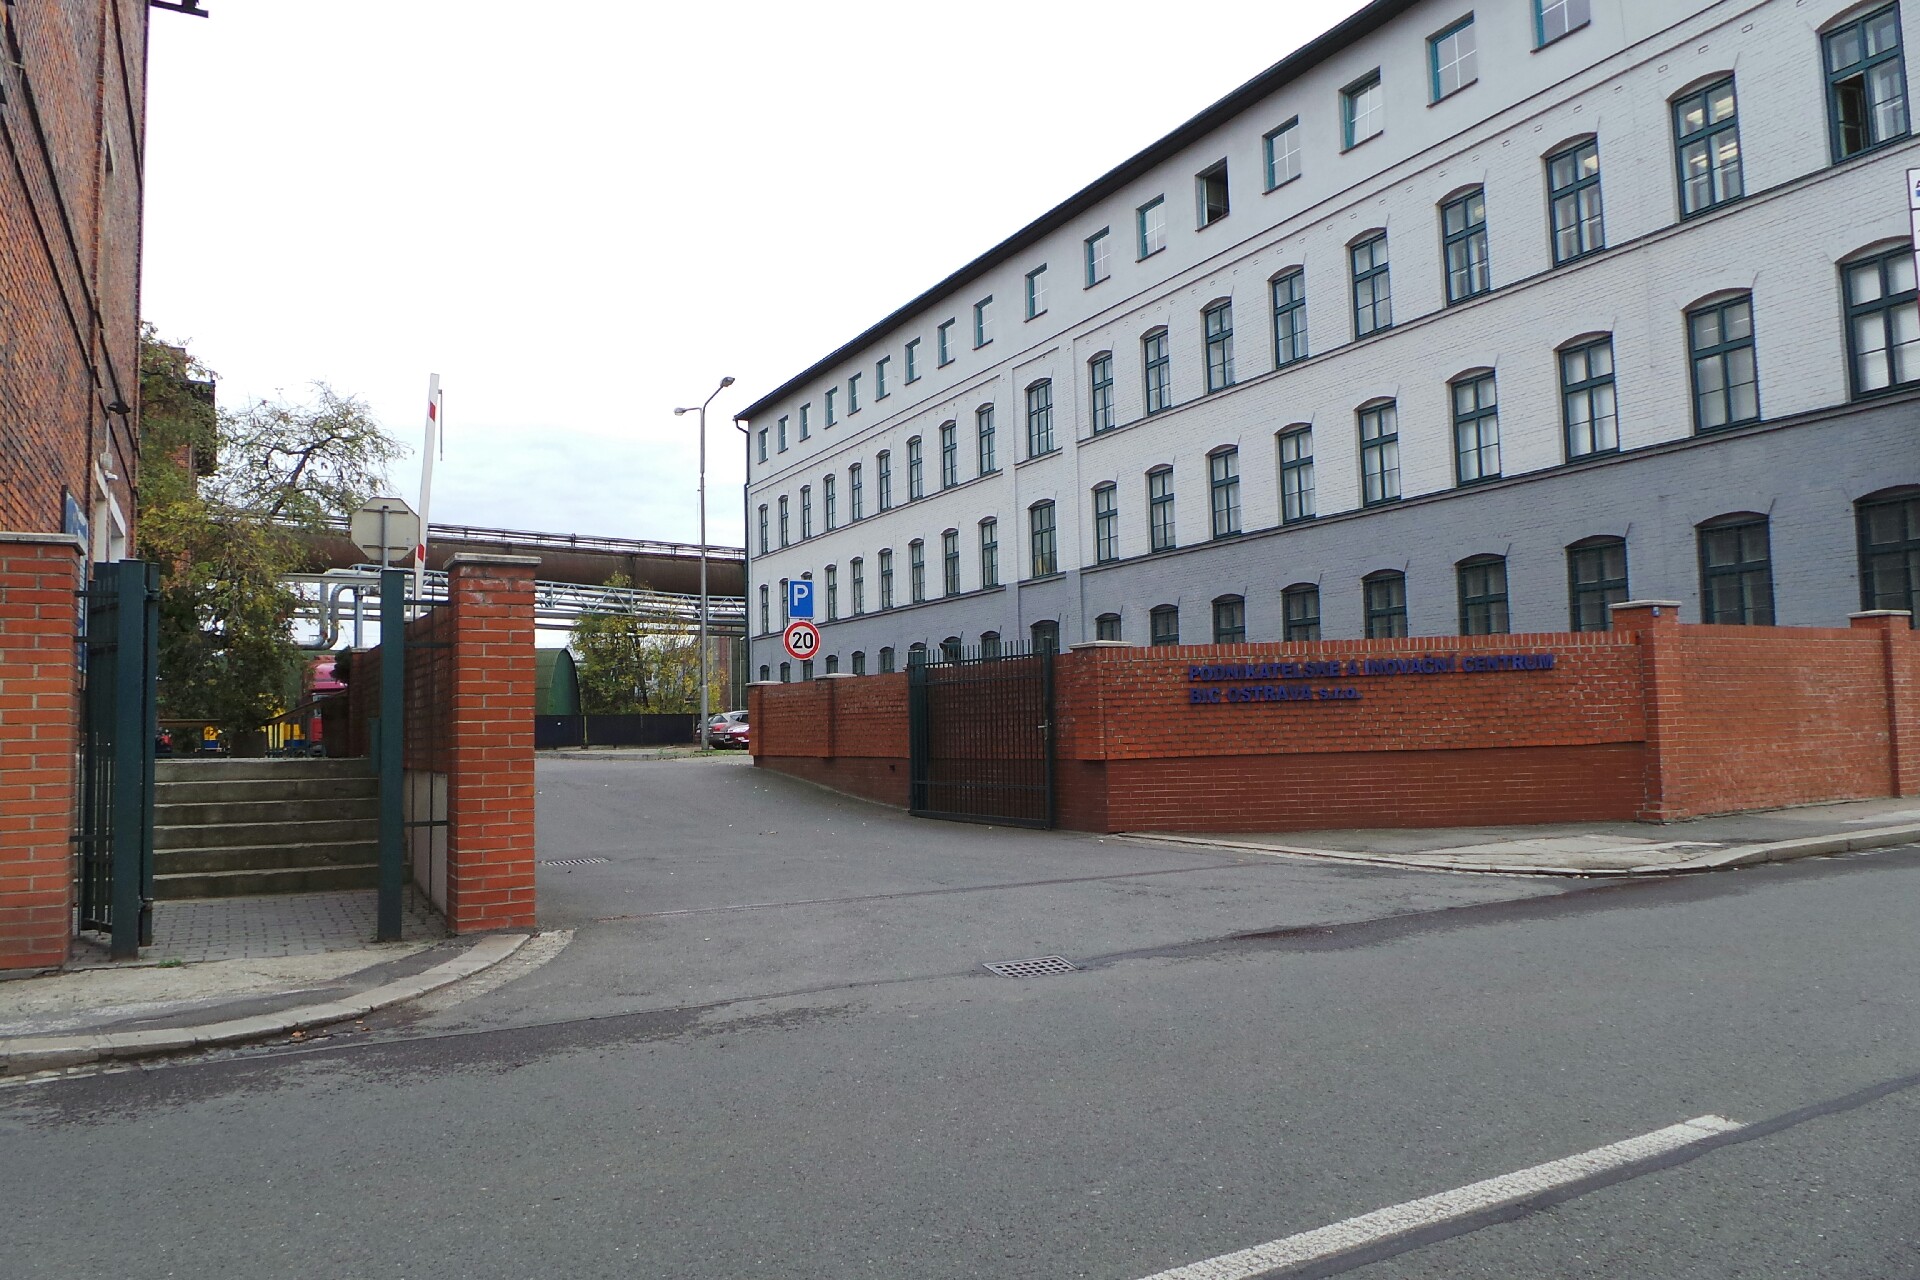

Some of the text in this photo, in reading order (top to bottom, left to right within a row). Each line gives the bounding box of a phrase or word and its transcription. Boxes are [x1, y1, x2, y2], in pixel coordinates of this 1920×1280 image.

[793, 584, 809, 606] P
[792, 631, 814, 649] 20
[1347, 659, 1359, 676] A
[1462, 654, 1554, 673] CENTRUM
[1190, 685, 1362, 704] BIC OSTRAVA s.r.o.
